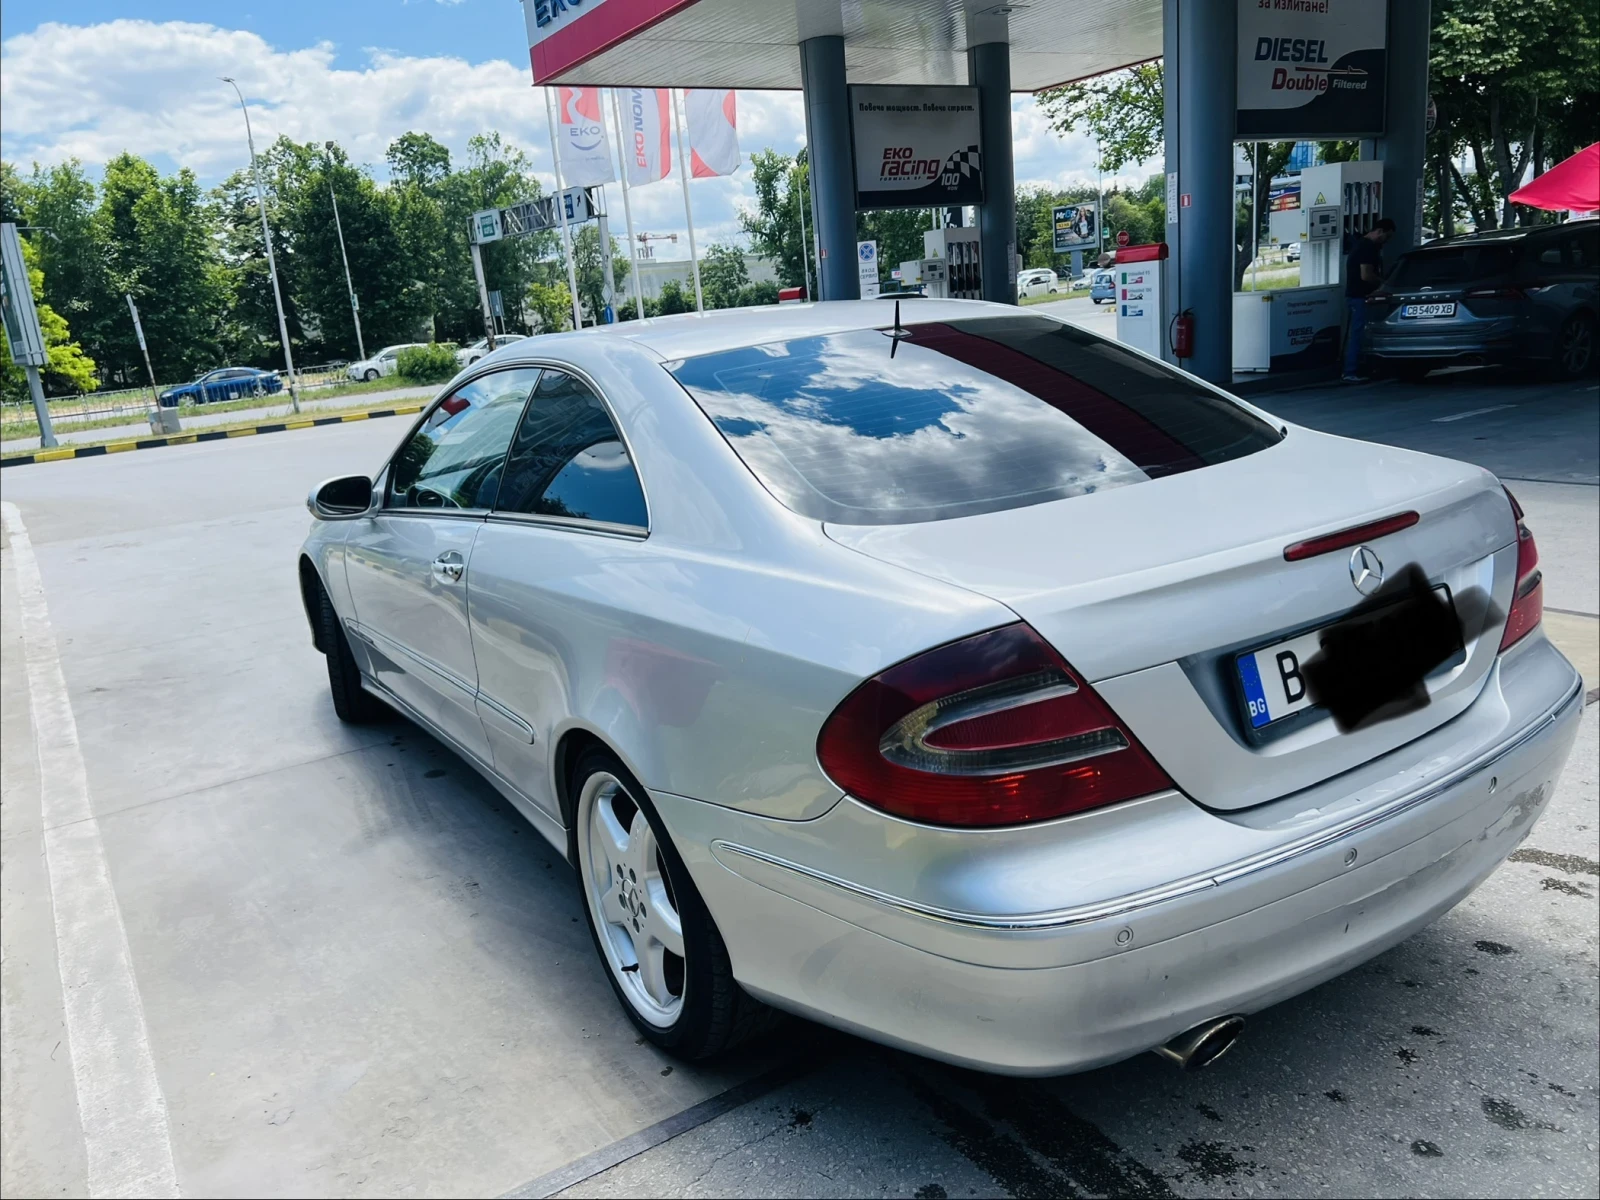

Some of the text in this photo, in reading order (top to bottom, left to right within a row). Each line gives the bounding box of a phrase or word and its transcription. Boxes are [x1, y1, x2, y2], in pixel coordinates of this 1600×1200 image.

[1254, 37, 1328, 63] DIESEL
[1271, 68, 1368, 92] Double Filtered
[570, 126, 601, 137] EKO
[882, 147, 914, 160] EKO
[880, 159, 941, 180] racing
[941, 172, 960, 187] 100
[1407, 304, 1453, 316] CB 5409 XB
[1287, 326, 1314, 337] DIESEL
[1248, 698, 1266, 717] BG
